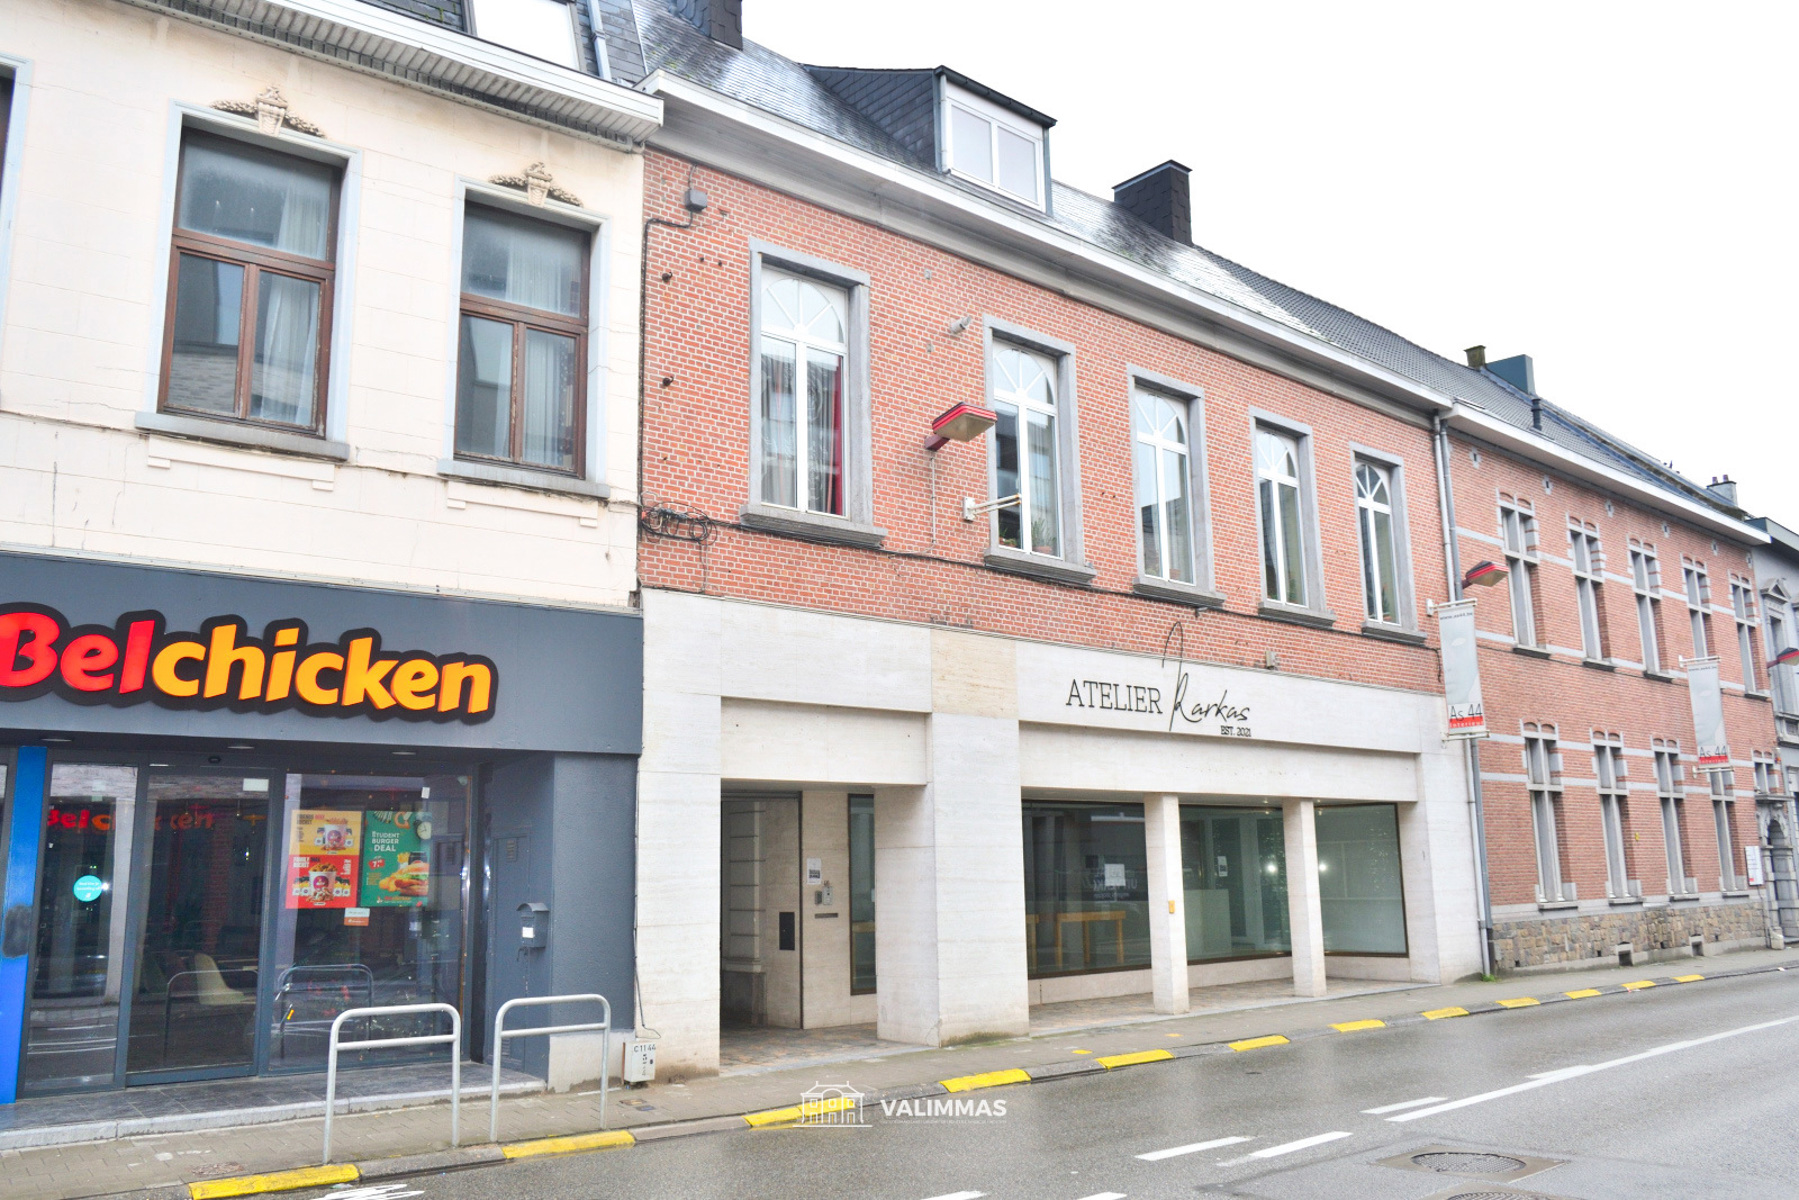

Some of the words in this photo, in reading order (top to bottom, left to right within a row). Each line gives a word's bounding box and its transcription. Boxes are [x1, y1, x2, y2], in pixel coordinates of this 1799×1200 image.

[0, 612, 491, 714] Belchicken
[1066, 679, 1163, 715] ATELIER
[1449, 705, 1465, 722] As
[1467, 703, 1483, 720] 44
[1714, 745, 1727, 758] 44
[371, 830, 400, 839] STUDENT
[373, 844, 397, 852] DEAL
